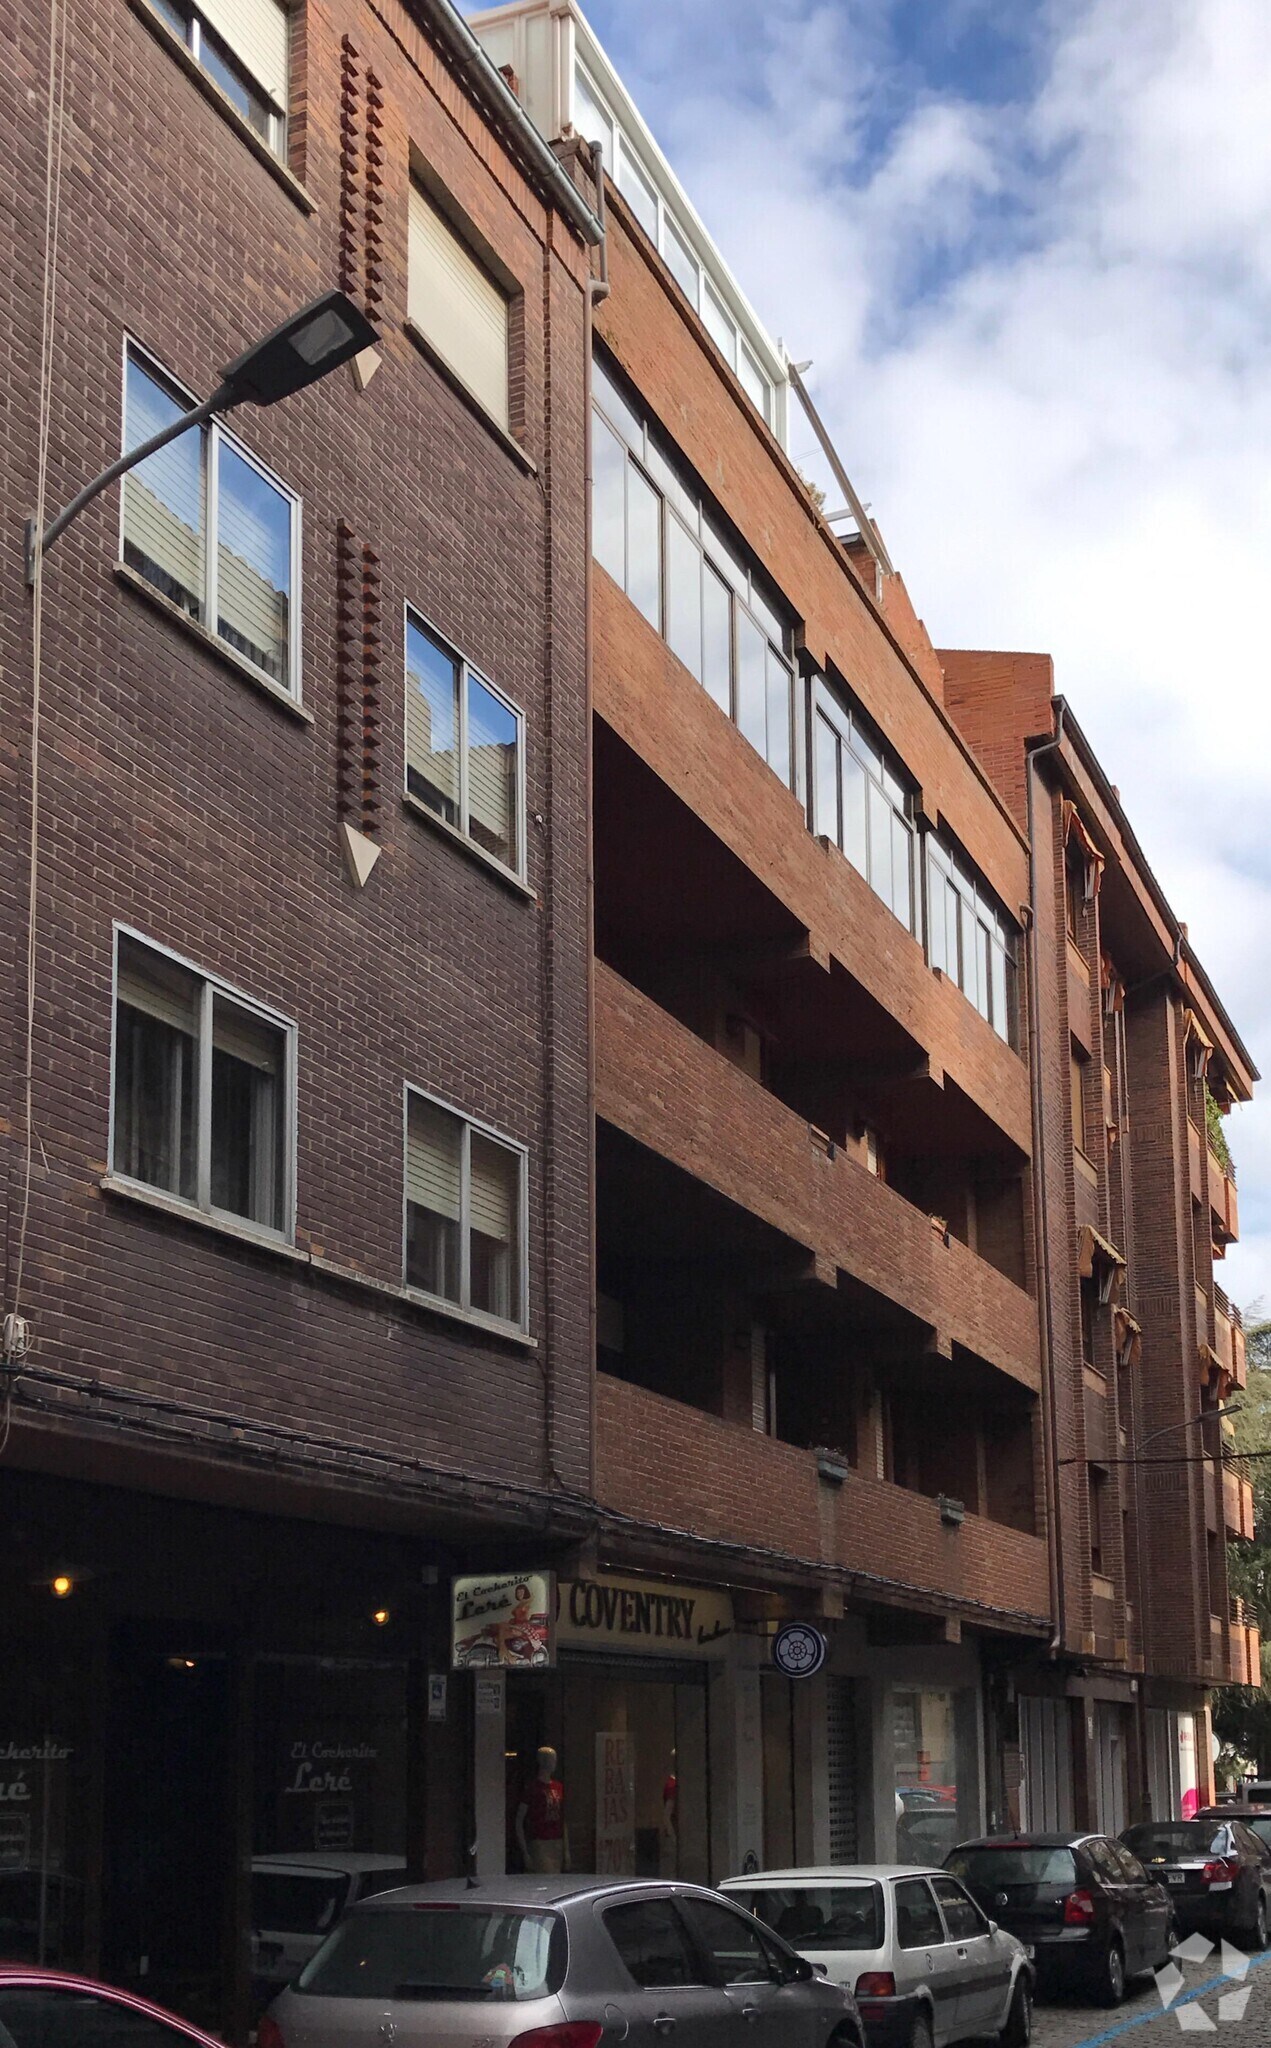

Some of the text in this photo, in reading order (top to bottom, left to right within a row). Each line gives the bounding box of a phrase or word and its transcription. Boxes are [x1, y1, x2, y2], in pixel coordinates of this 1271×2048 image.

[456, 1575, 532, 1602] El Cocherito
[569, 1579, 696, 1640] COVENTRY
[291, 1741, 307, 1759] El
